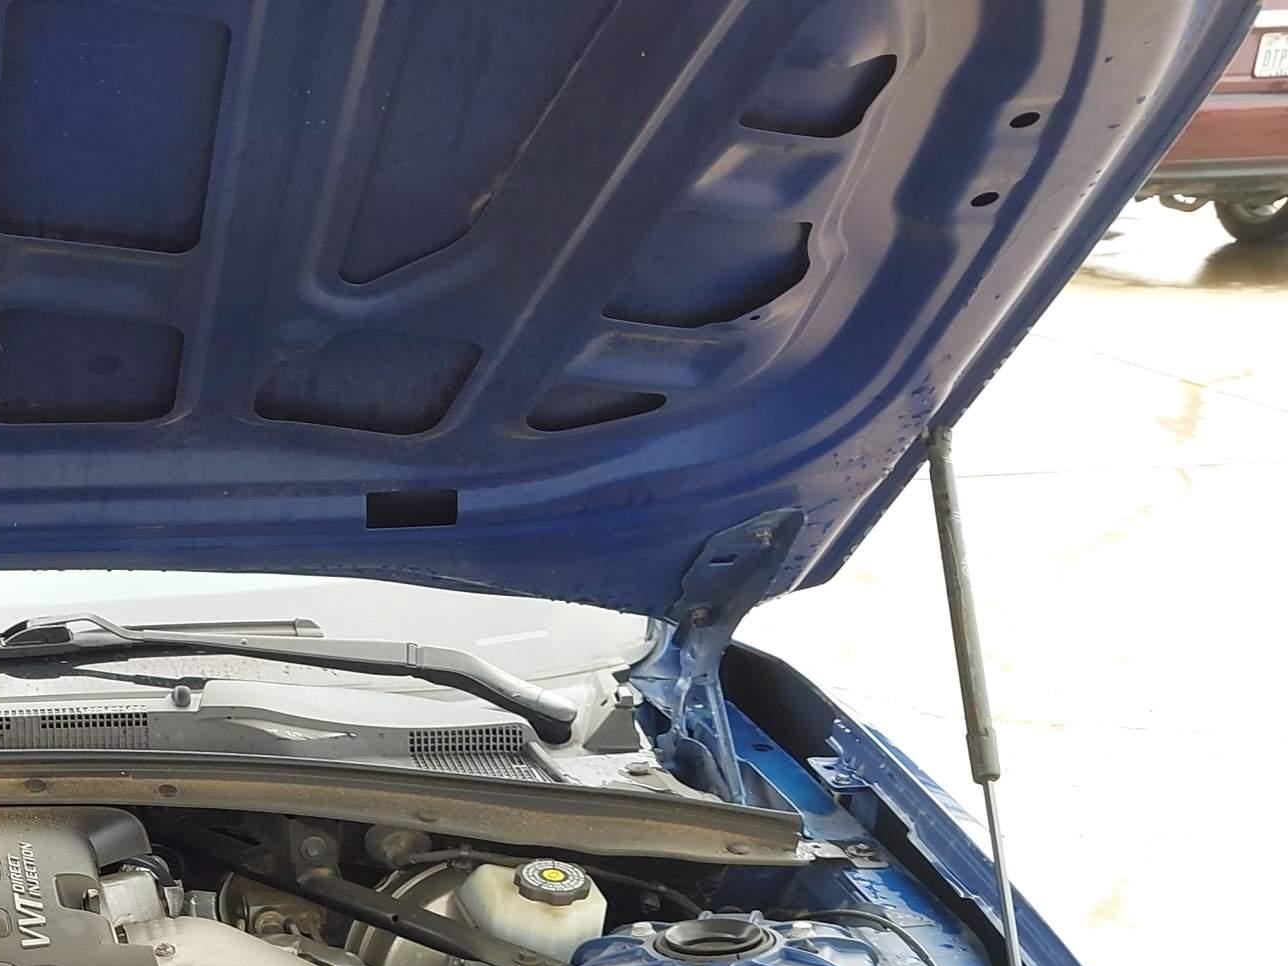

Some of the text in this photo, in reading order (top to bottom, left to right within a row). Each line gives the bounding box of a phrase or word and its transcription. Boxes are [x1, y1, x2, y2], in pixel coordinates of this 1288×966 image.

[8, 853, 25, 895] DIRECT
[20, 841, 42, 899] INJECTION
[14, 892, 50, 947] VVT
